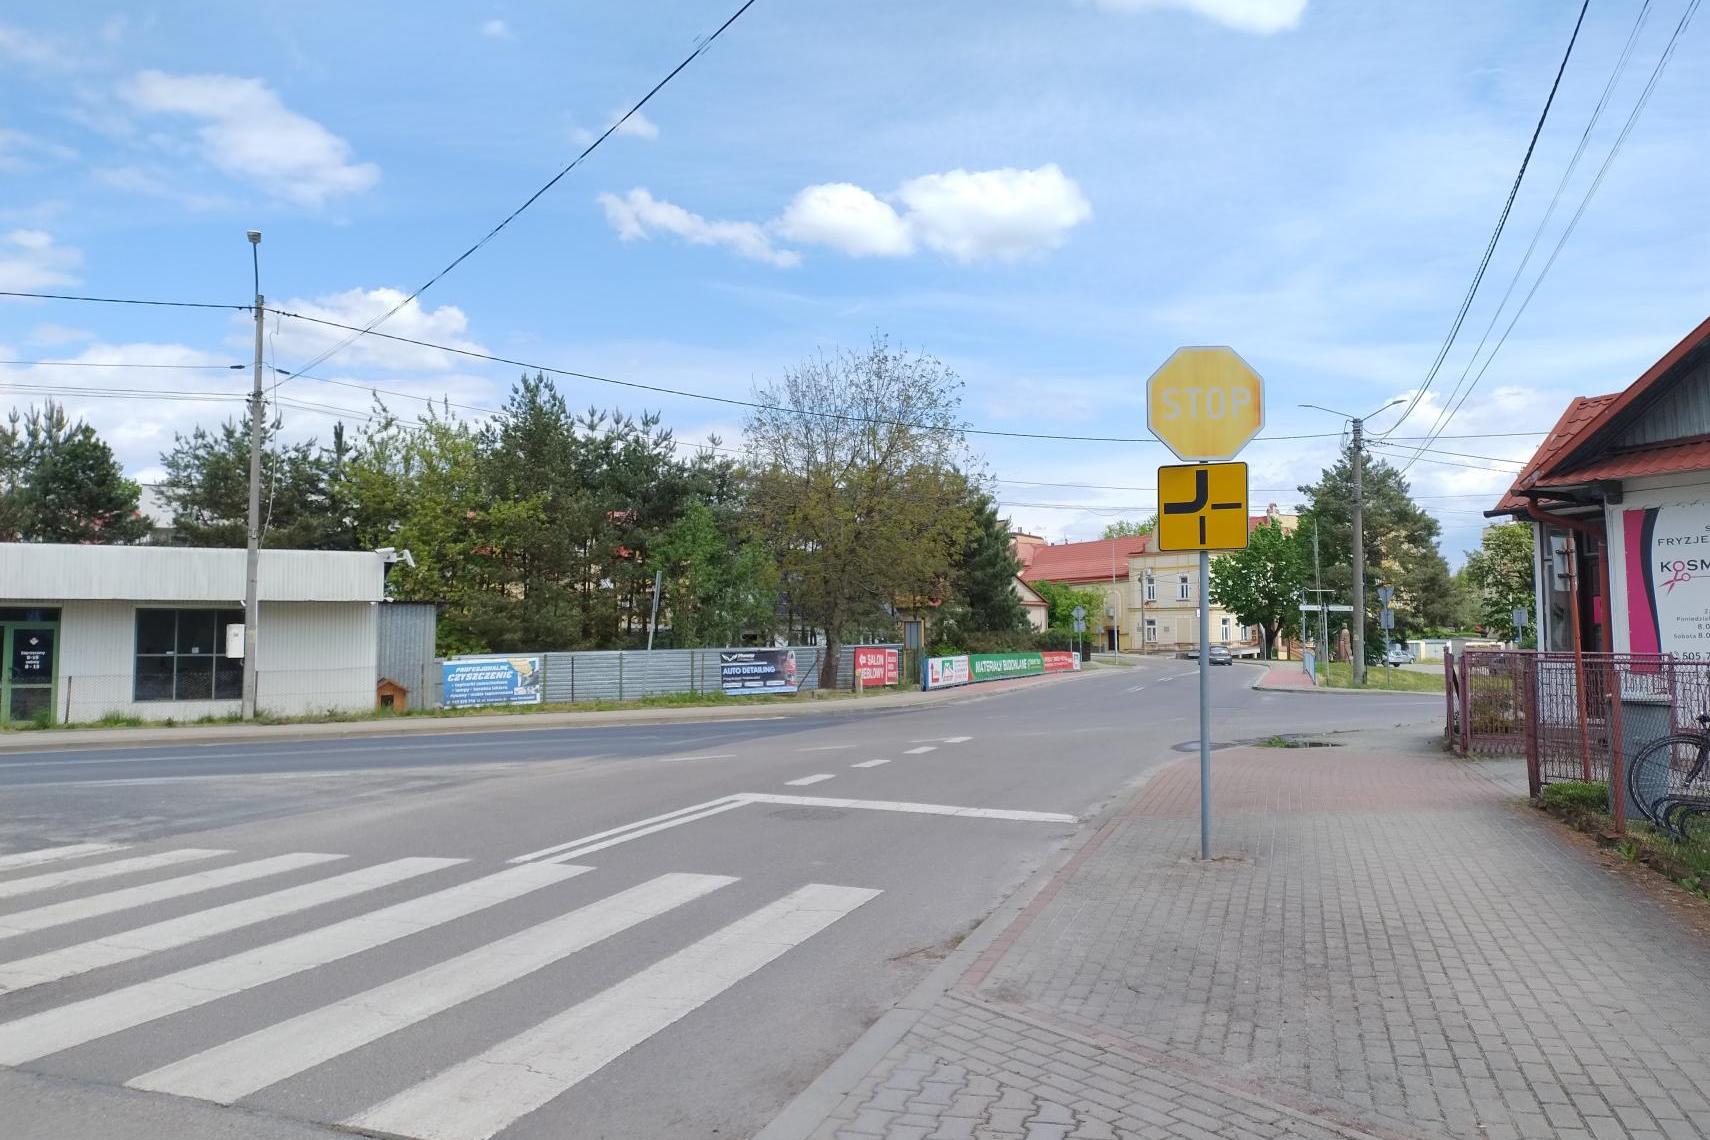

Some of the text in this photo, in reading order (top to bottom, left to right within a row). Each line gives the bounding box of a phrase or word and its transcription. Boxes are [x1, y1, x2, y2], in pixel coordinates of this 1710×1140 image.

[1163, 387, 1251, 419] STOP
[1658, 535, 1710, 547] FRYZJE
[1673, 632, 1697, 640] Sobota
[868, 654, 884, 666] SALON
[1682, 651, 1701, 660] 505
[448, 671, 512, 682] CZYSZCZENIE
[723, 667, 741, 675] AUTO
